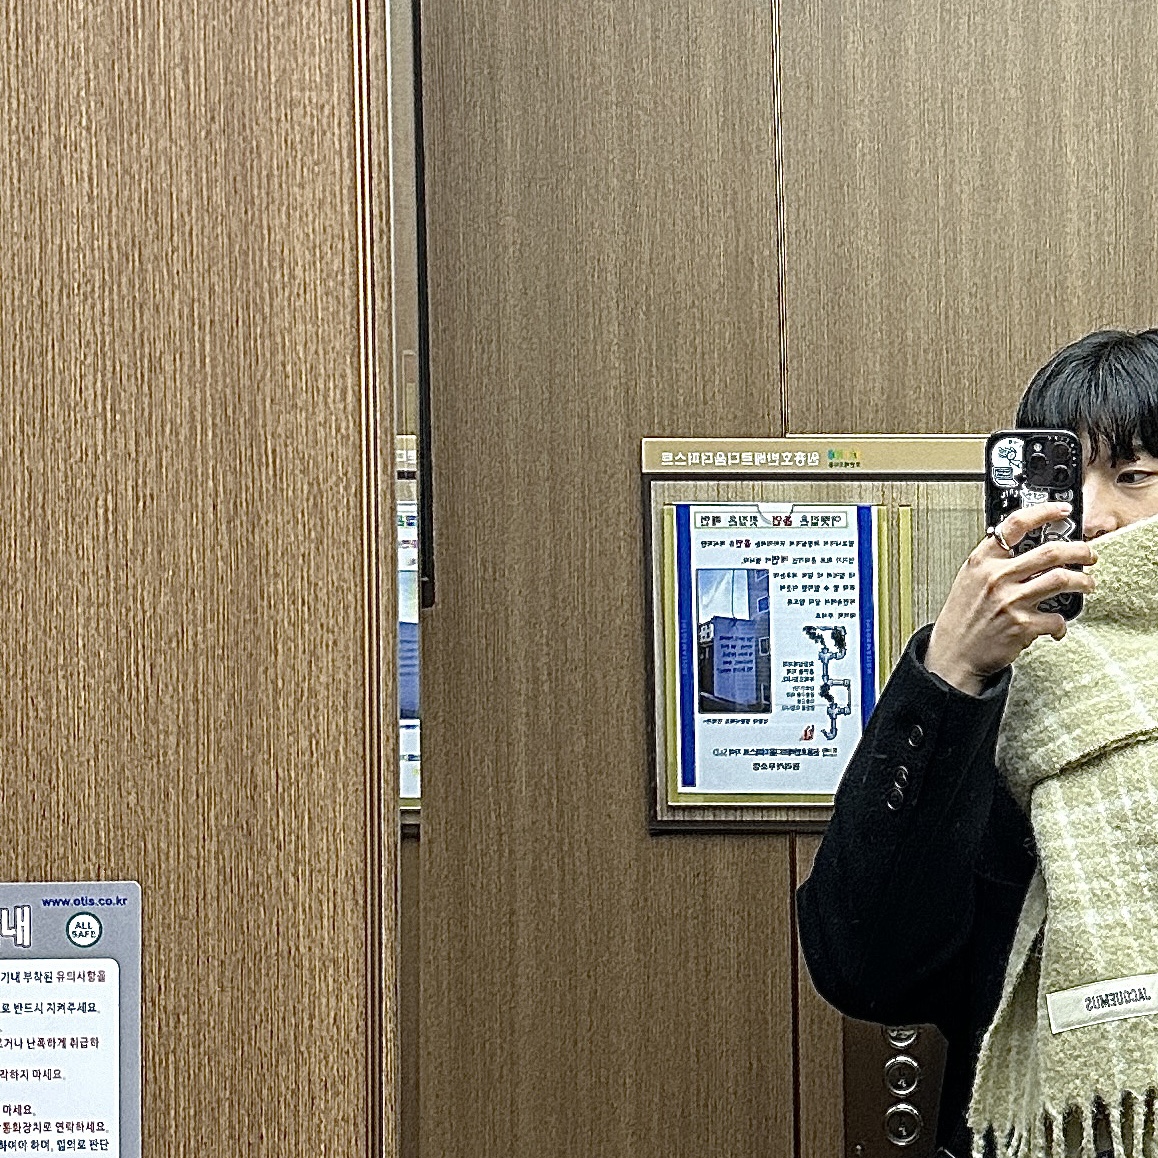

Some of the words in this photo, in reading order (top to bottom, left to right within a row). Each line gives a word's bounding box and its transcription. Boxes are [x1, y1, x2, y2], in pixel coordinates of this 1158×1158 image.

[42, 896, 128, 907] www.otis.co.kr
[74, 921, 93, 930] ALL
[71, 930, 96, 939] SAFE
[23, 971, 54, 984] 부착된
[56, 970, 106, 983] 유의사항을
[14, 1002, 44, 1015] 반드시
[47, 1002, 101, 1014] 지켜주세요.
[27, 1037, 67, 1050] 난폭하게
[70, 1037, 99, 1050] 취급하
[32, 1069, 66, 1082] 마세요.
[3, 1104, 37, 1116] 마세요.
[0, 1121, 52, 1134] 통화장치로
[55, 1121, 109, 1134] 연락하세요.
[57, 1139, 86, 1152] 임의로
[89, 1139, 110, 1151] 판단
